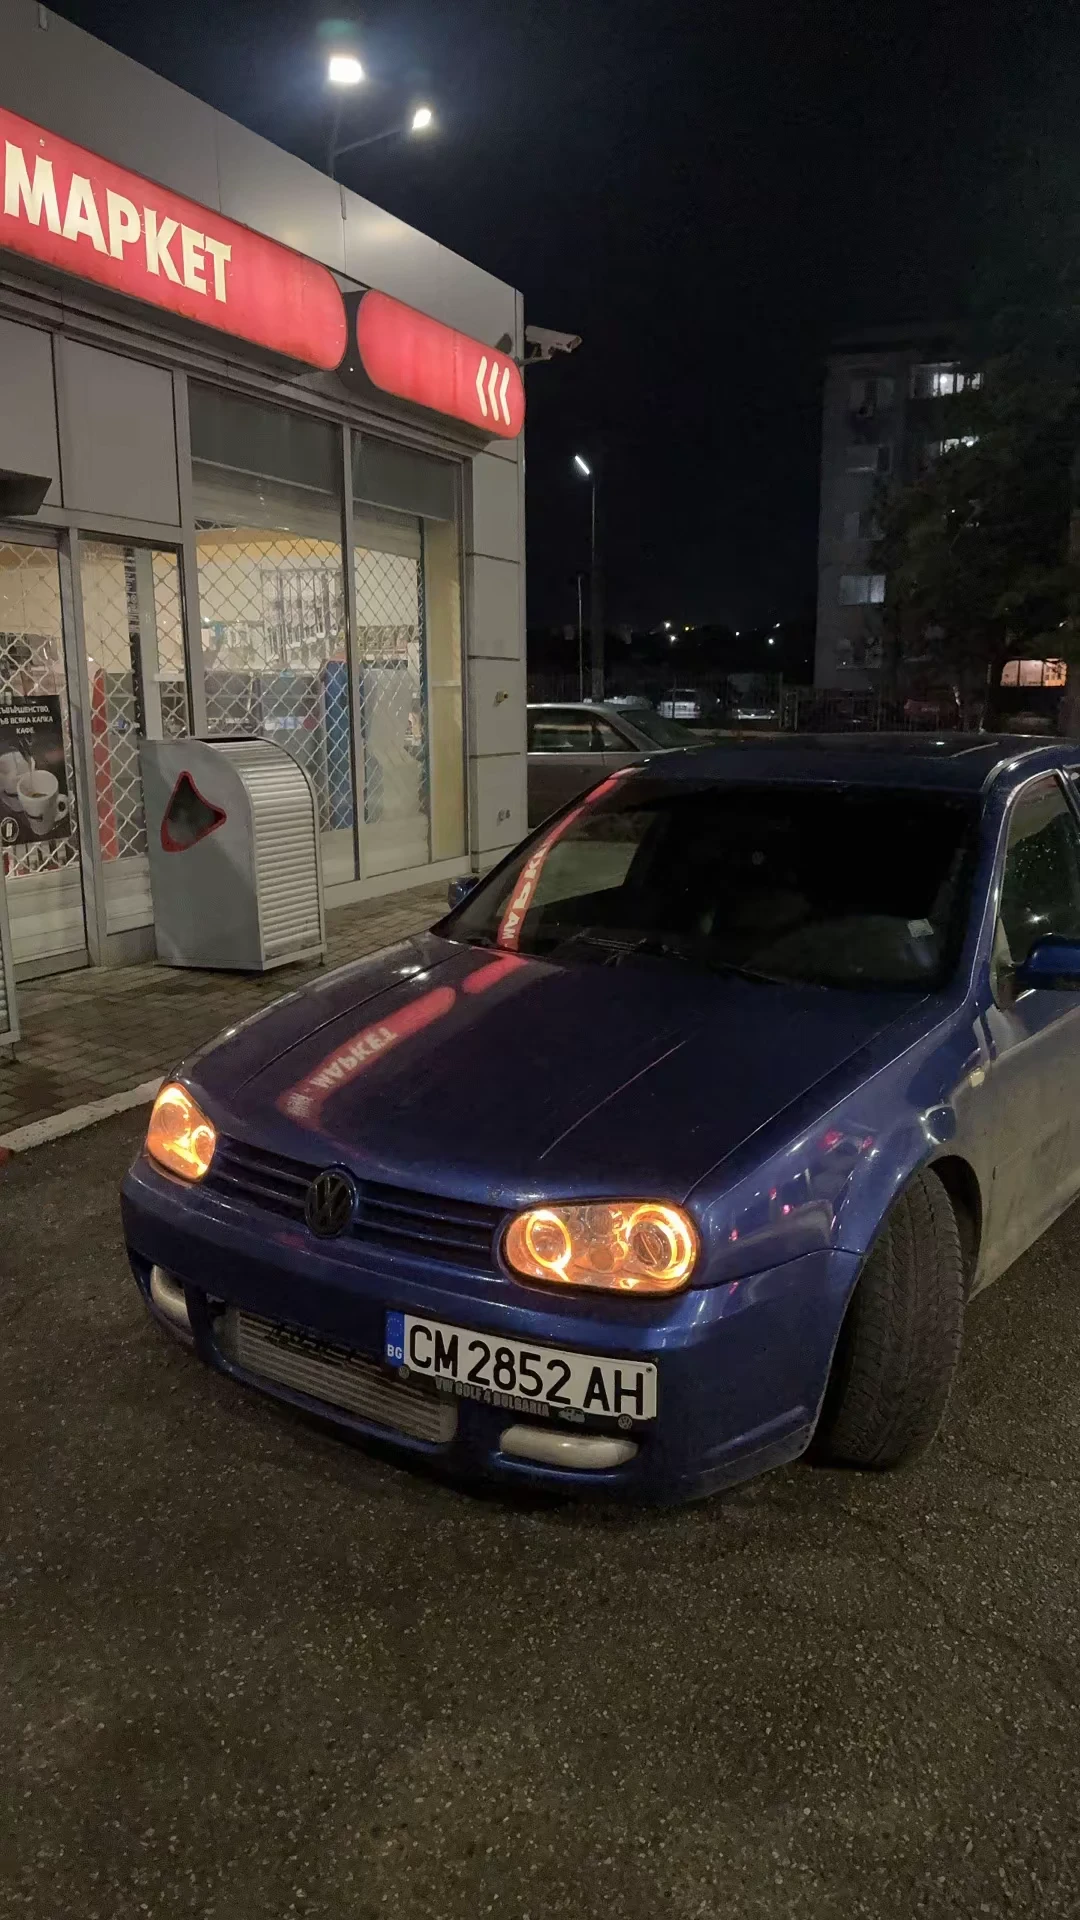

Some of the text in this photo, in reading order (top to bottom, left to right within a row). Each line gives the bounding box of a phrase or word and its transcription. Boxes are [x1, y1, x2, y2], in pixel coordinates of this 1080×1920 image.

[4, 139, 232, 304] МАРКЕТ
[387, 1344, 403, 1359] BG
[409, 1324, 645, 1416] CM 2852 AH
[455, 1381, 483, 1402] GOLF
[493, 1390, 551, 1417] BULGARIA
